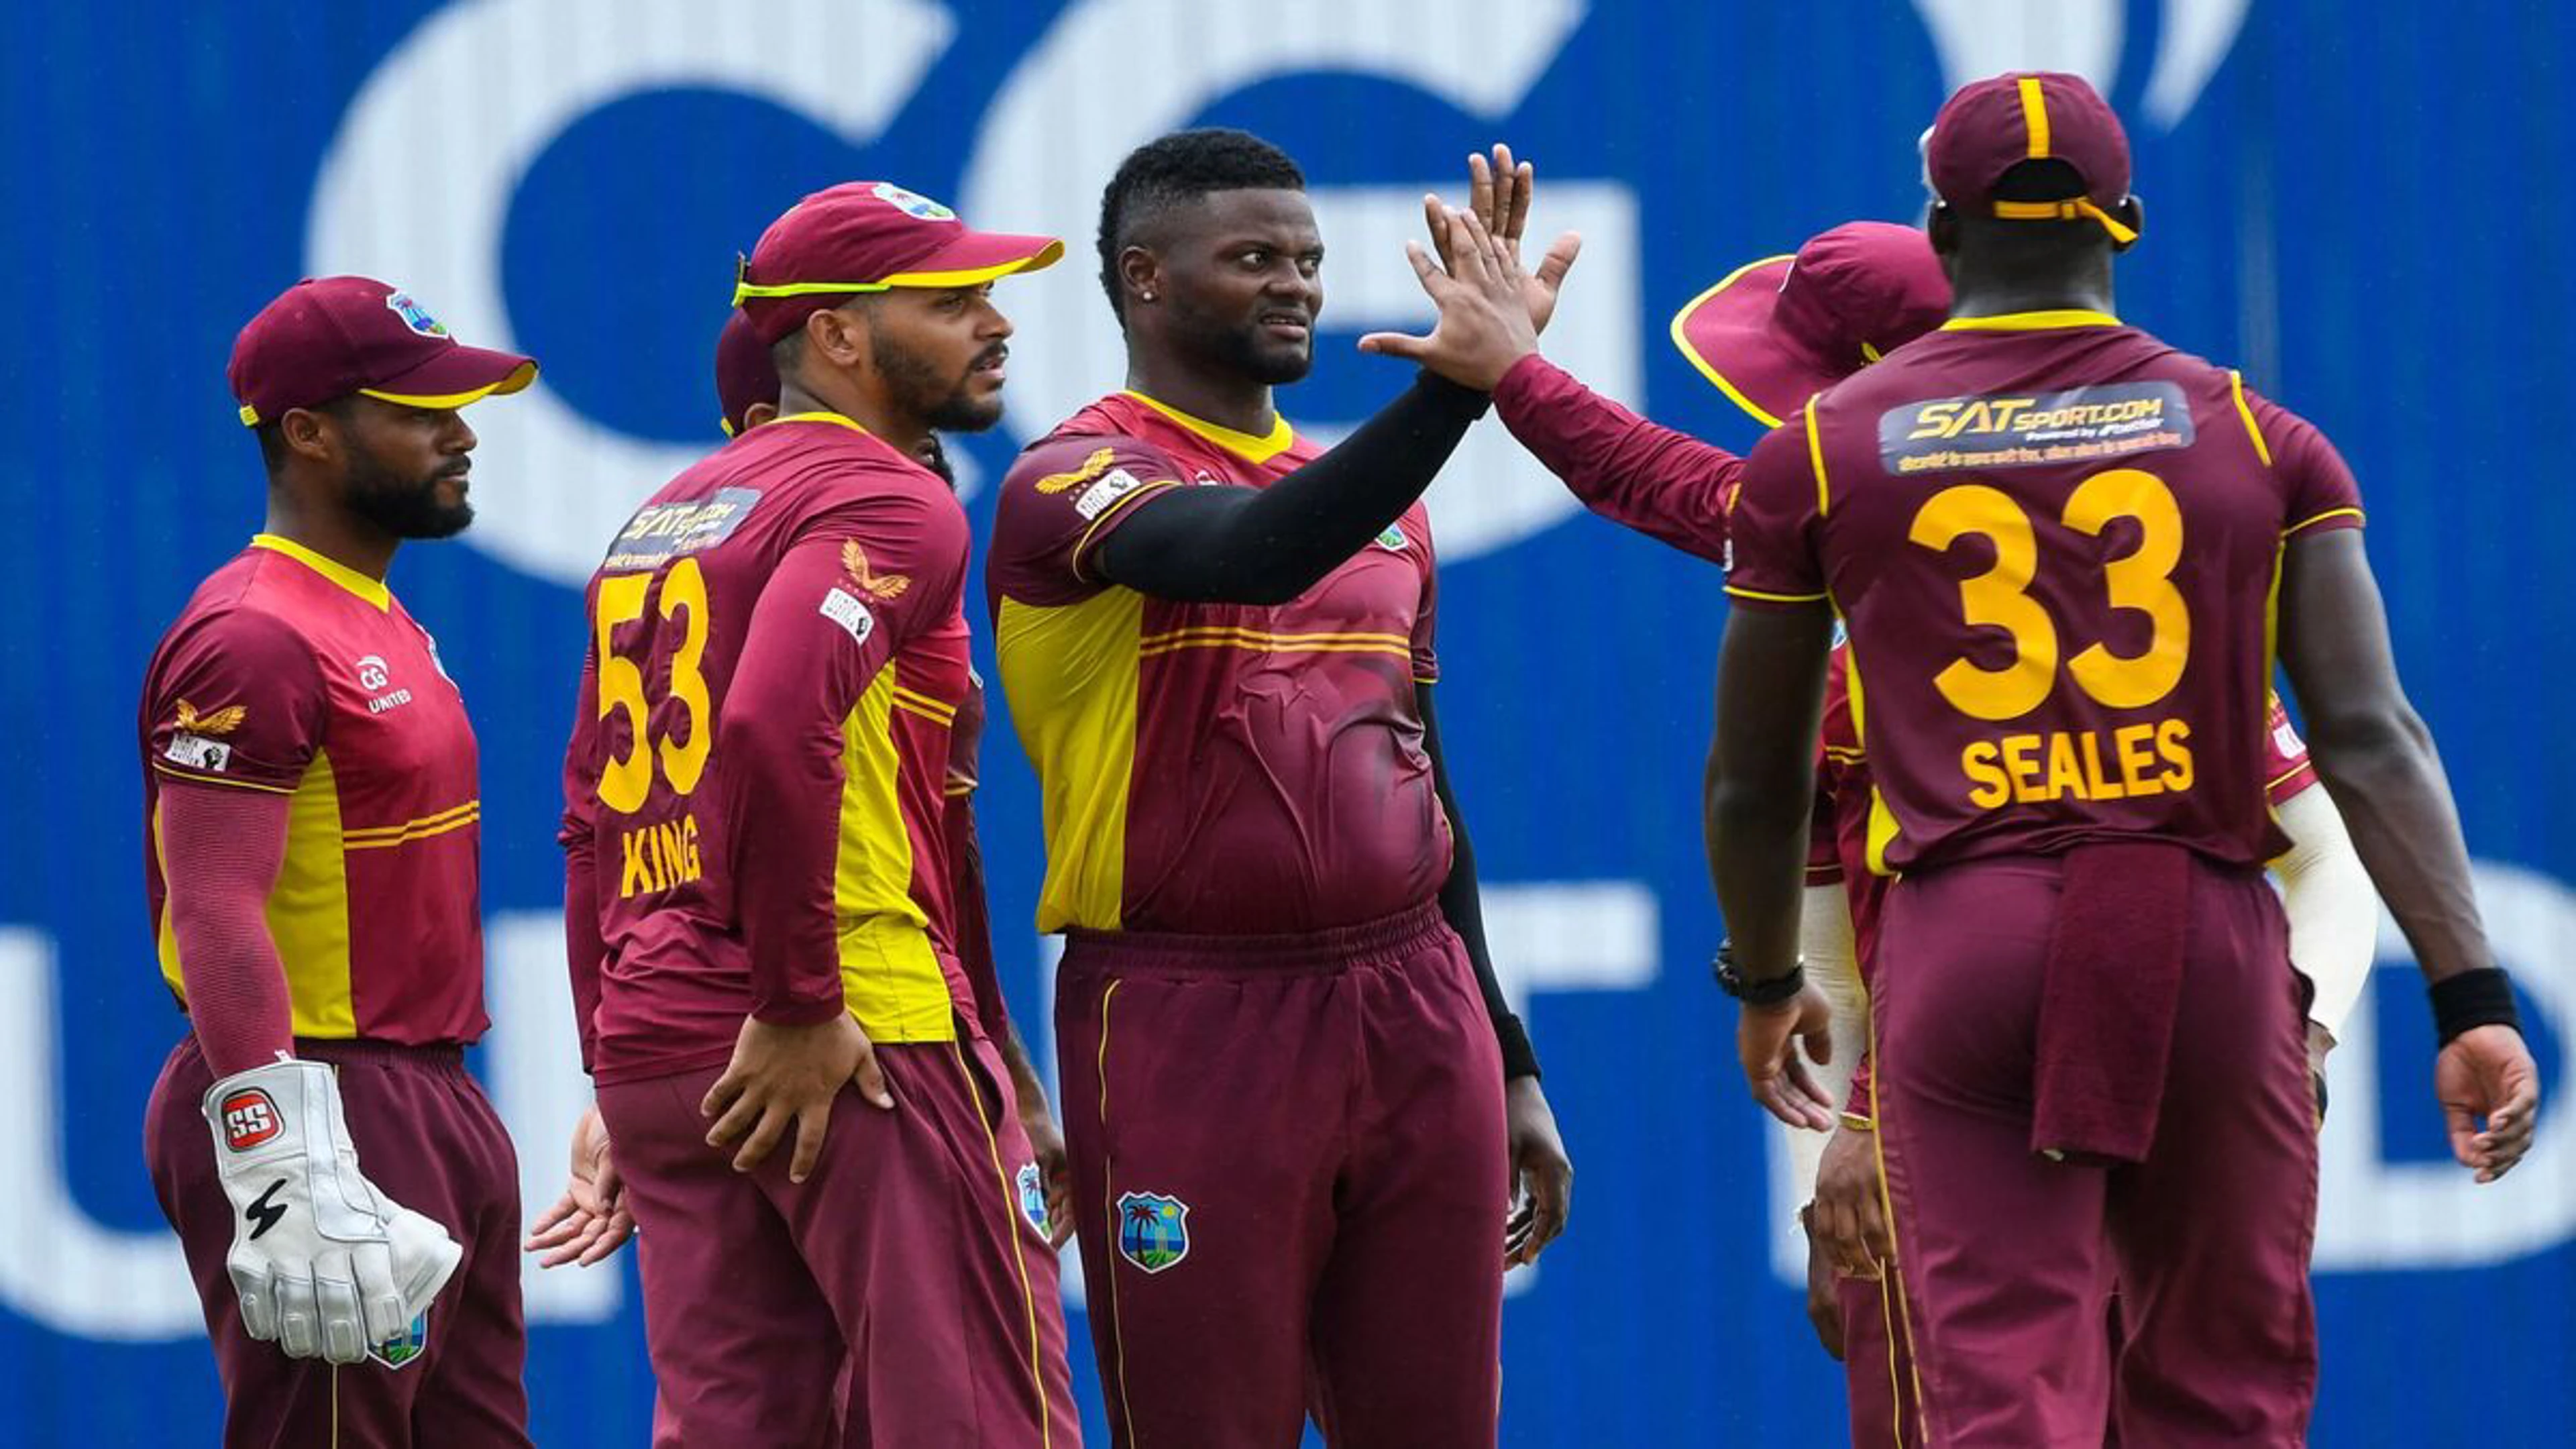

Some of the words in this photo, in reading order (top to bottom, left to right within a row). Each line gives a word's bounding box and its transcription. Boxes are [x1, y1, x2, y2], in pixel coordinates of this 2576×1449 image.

[1909, 469, 2190, 720] 33
[360, 667, 388, 690] CG
[369, 688, 412, 714] UNITED
[596, 557, 711, 814] 53
[1961, 718, 2194, 810] SEALES
[619, 814, 700, 898] KING
[227, 1102, 272, 1138] SS
